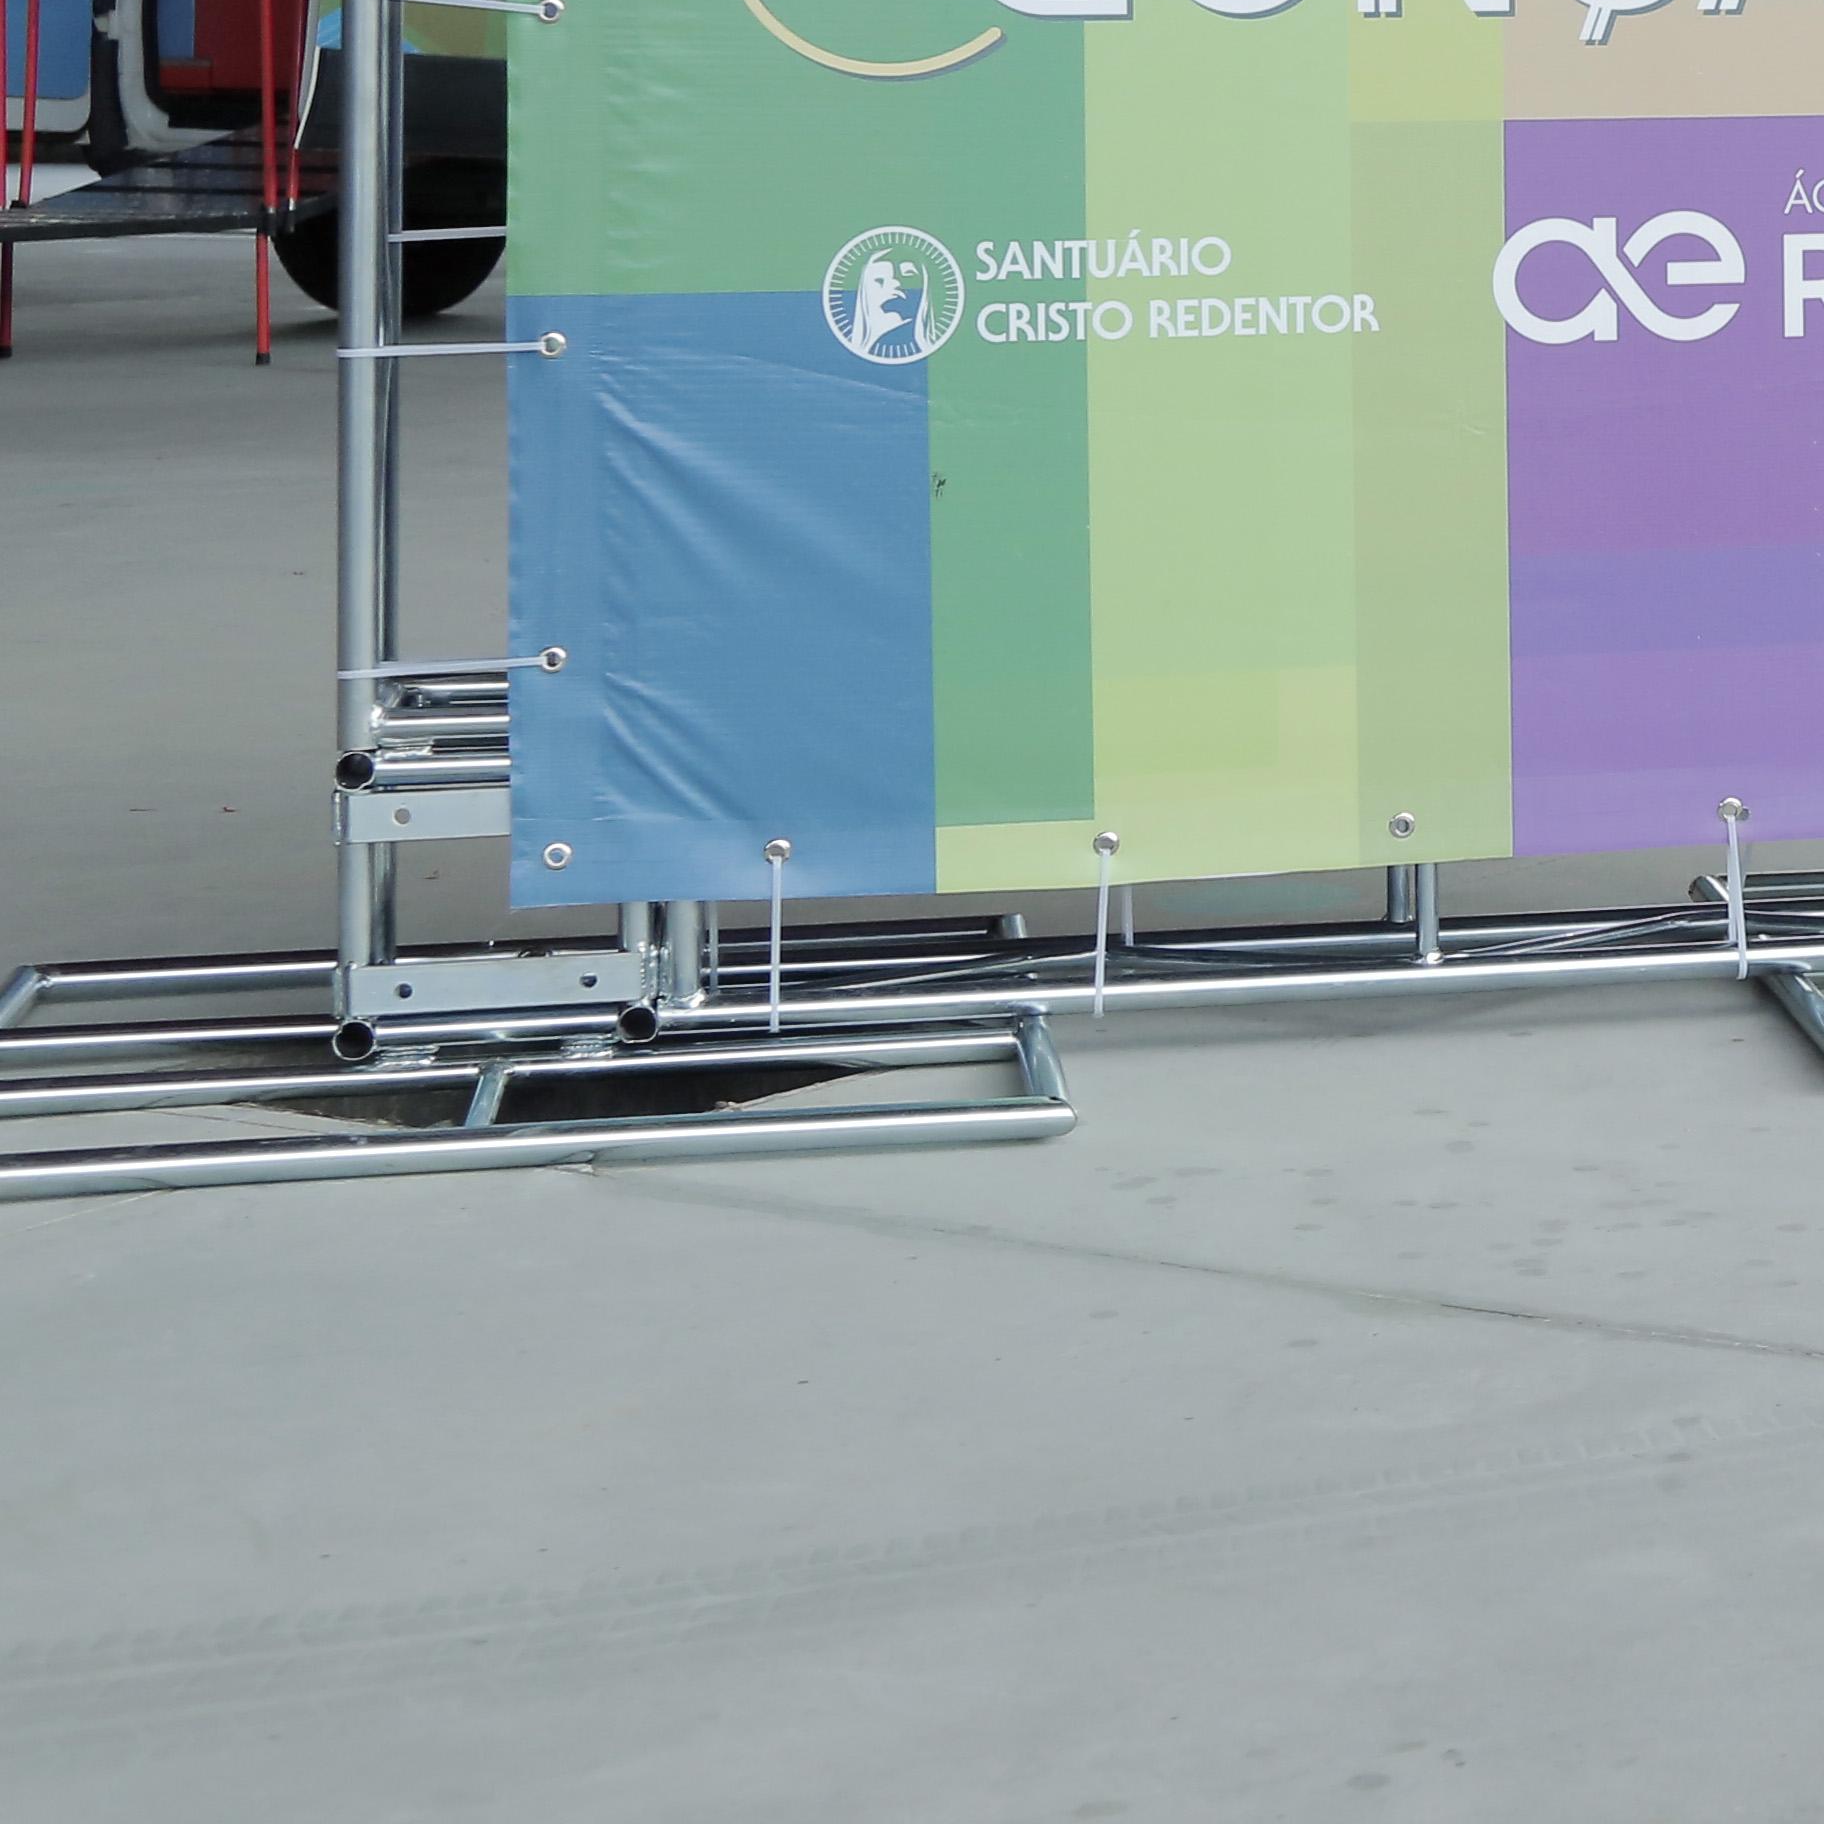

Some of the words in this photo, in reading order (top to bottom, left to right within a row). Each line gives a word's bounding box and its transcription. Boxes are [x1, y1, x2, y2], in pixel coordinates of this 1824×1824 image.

[975, 228, 1232, 282] SANTUÁRIO
[975, 299, 1134, 344] CRISTO
[1148, 292, 1381, 339] REDENTOR
